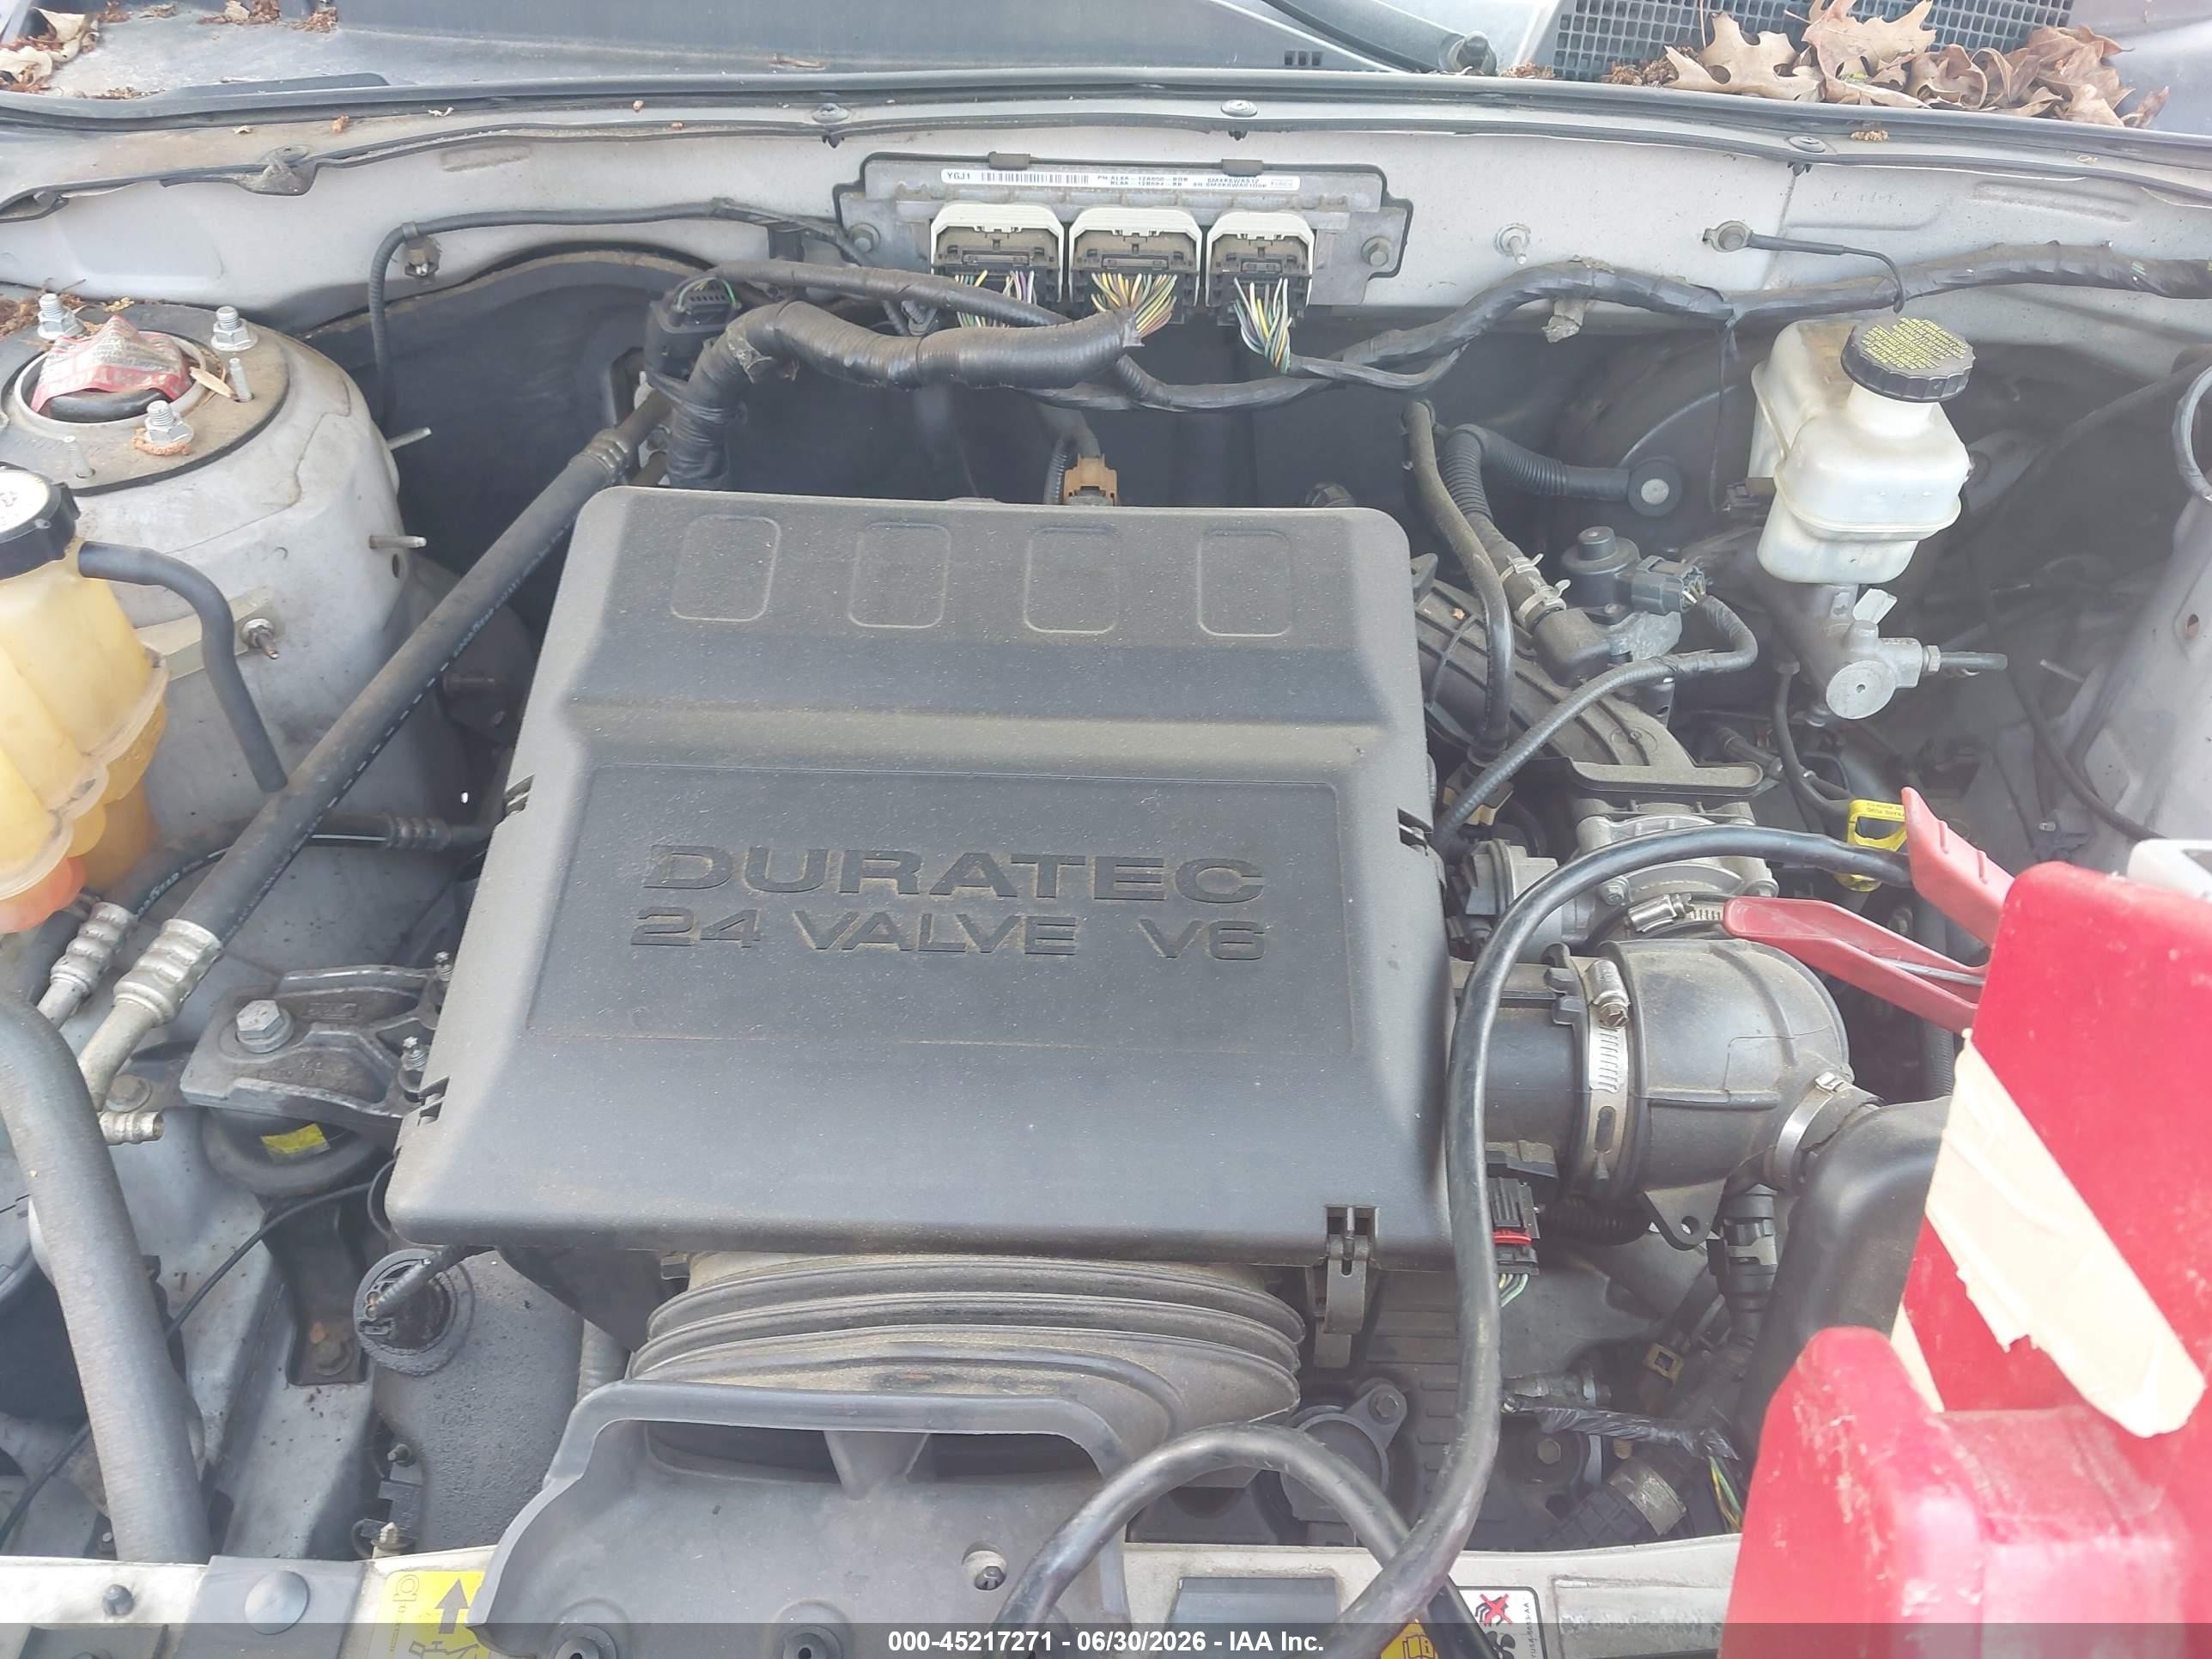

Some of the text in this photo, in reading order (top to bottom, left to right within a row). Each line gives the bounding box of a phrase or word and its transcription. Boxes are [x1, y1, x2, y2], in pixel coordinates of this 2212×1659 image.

[643, 844, 1265, 903] DURATEC
[630, 906, 1267, 960] 24 VALVE V6
